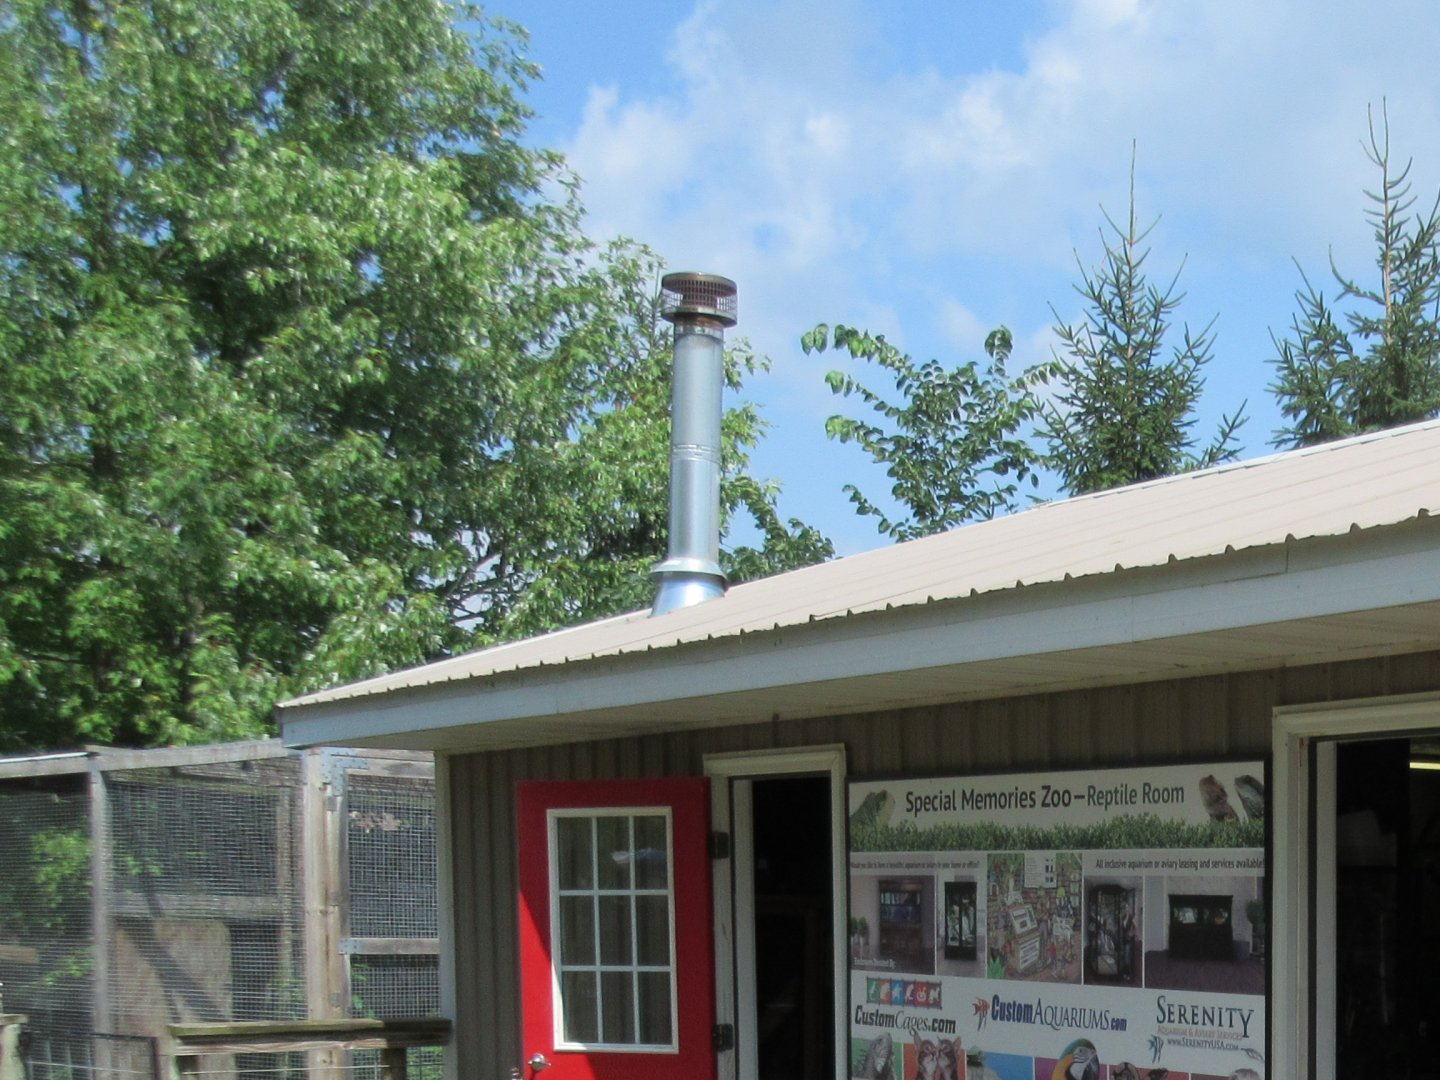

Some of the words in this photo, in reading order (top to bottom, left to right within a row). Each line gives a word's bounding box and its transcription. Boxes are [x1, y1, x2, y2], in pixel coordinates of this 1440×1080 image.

[906, 790, 956, 817] Special
[961, 786, 1036, 811] Memories
[1142, 782, 1185, 804] Room
[1104, 858, 1127, 868] inclusive
[1128, 859, 1153, 870] aquarium
[1161, 859, 1177, 871] aviary
[1178, 859, 1198, 871] leasing
[1199, 859, 1210, 868] and
[1211, 859, 1235, 868] services
[854, 1005, 957, 1036] CustomCages.com
[1156, 995, 1255, 1038] SERENITY
